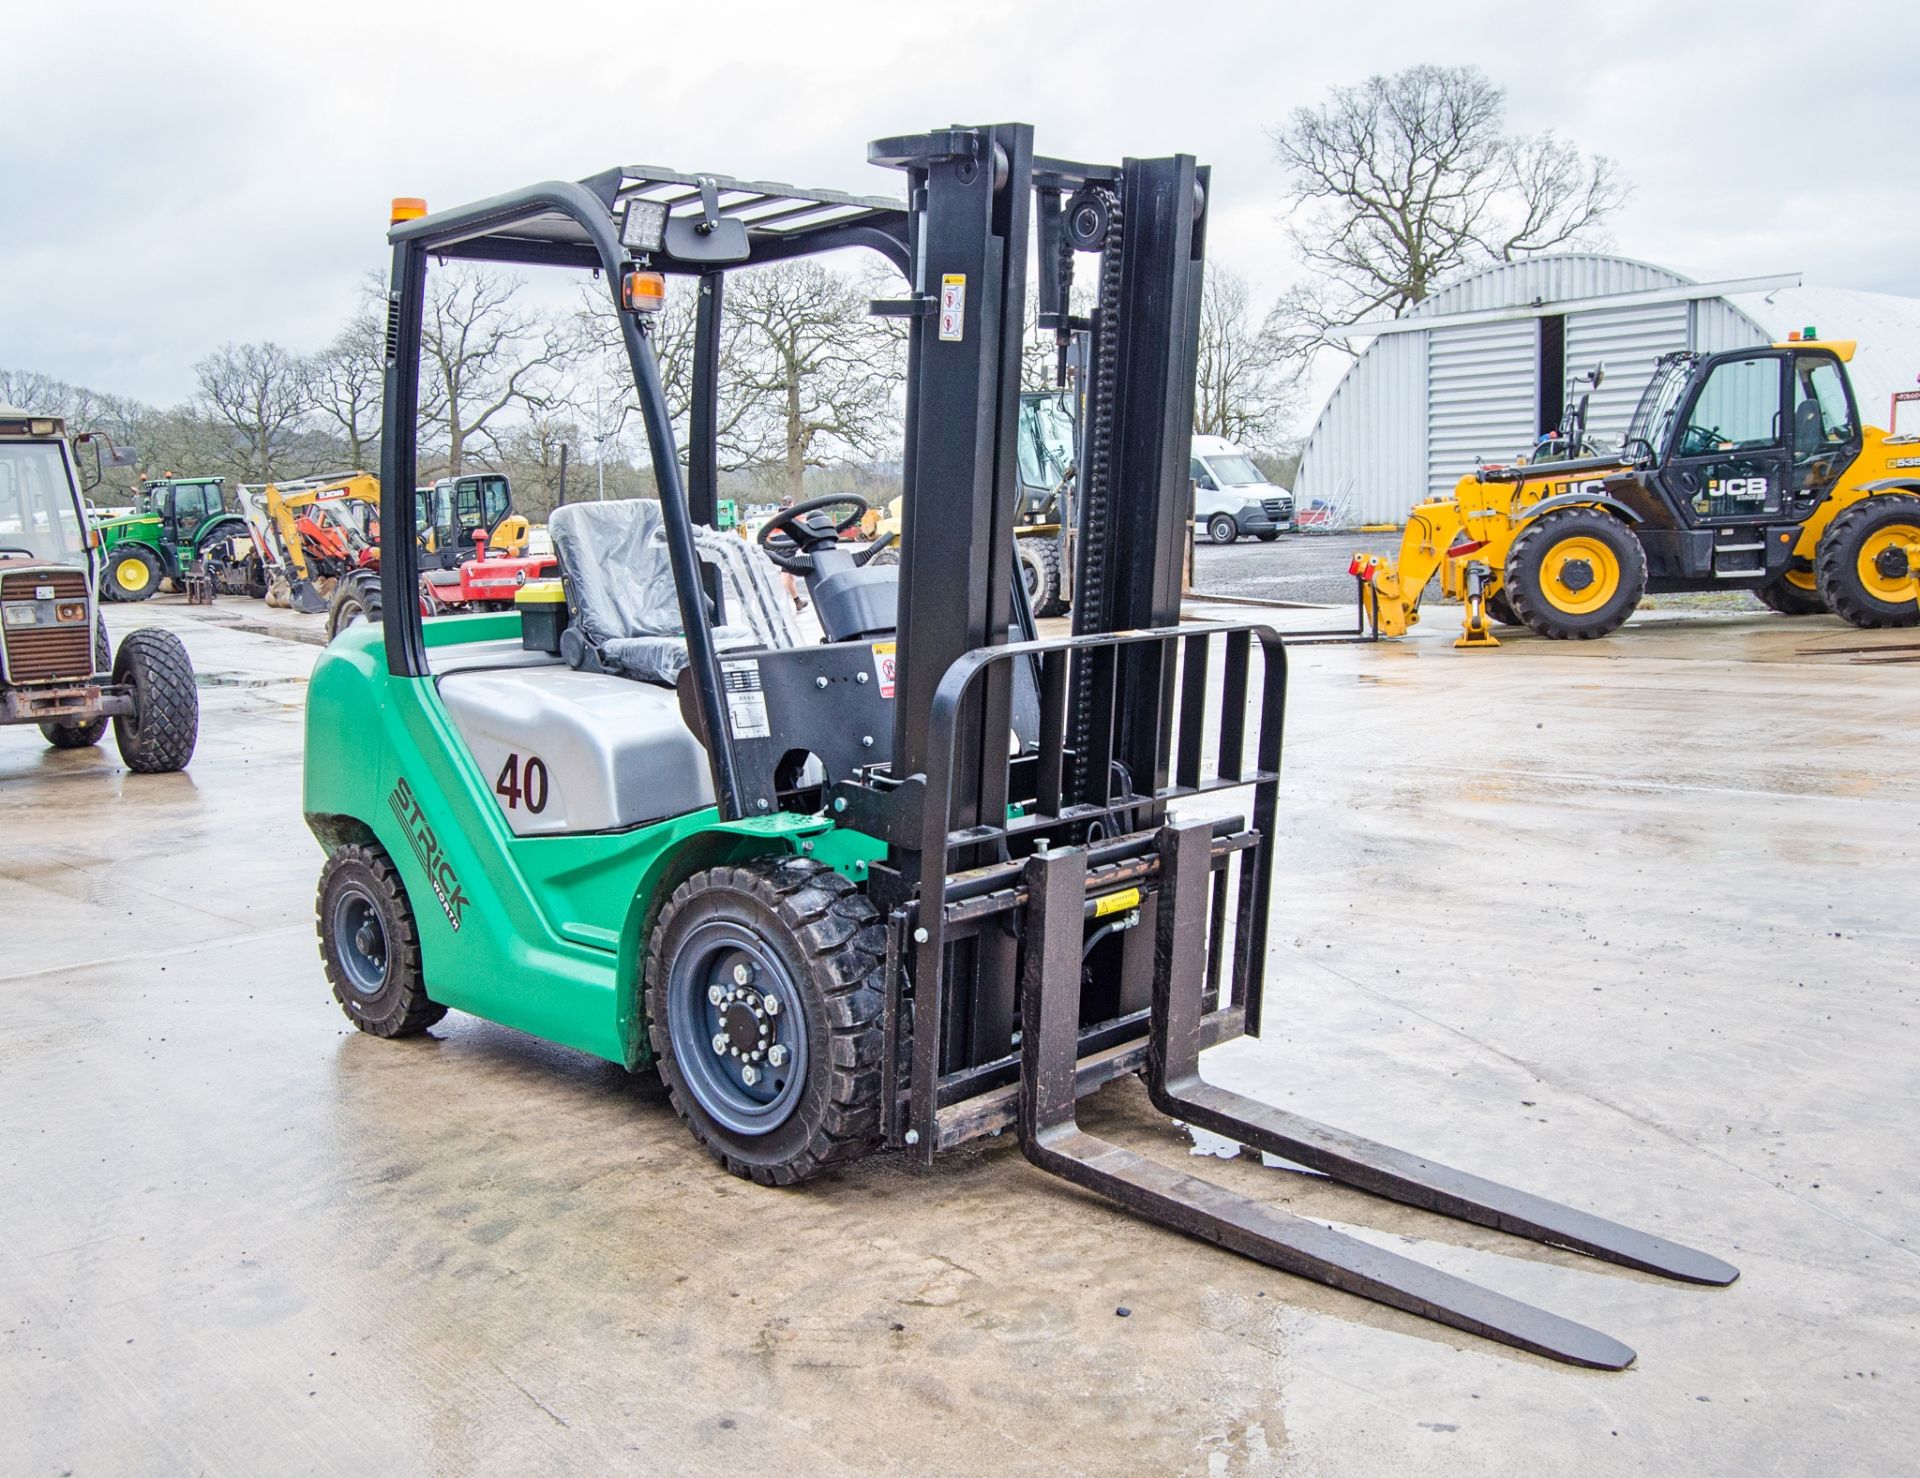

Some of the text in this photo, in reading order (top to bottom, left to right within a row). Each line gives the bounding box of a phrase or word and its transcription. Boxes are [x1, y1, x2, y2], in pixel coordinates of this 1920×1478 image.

[1709, 478, 1767, 496] JCB
[496, 753, 549, 814] 40
[432, 880, 459, 930] WORTH
